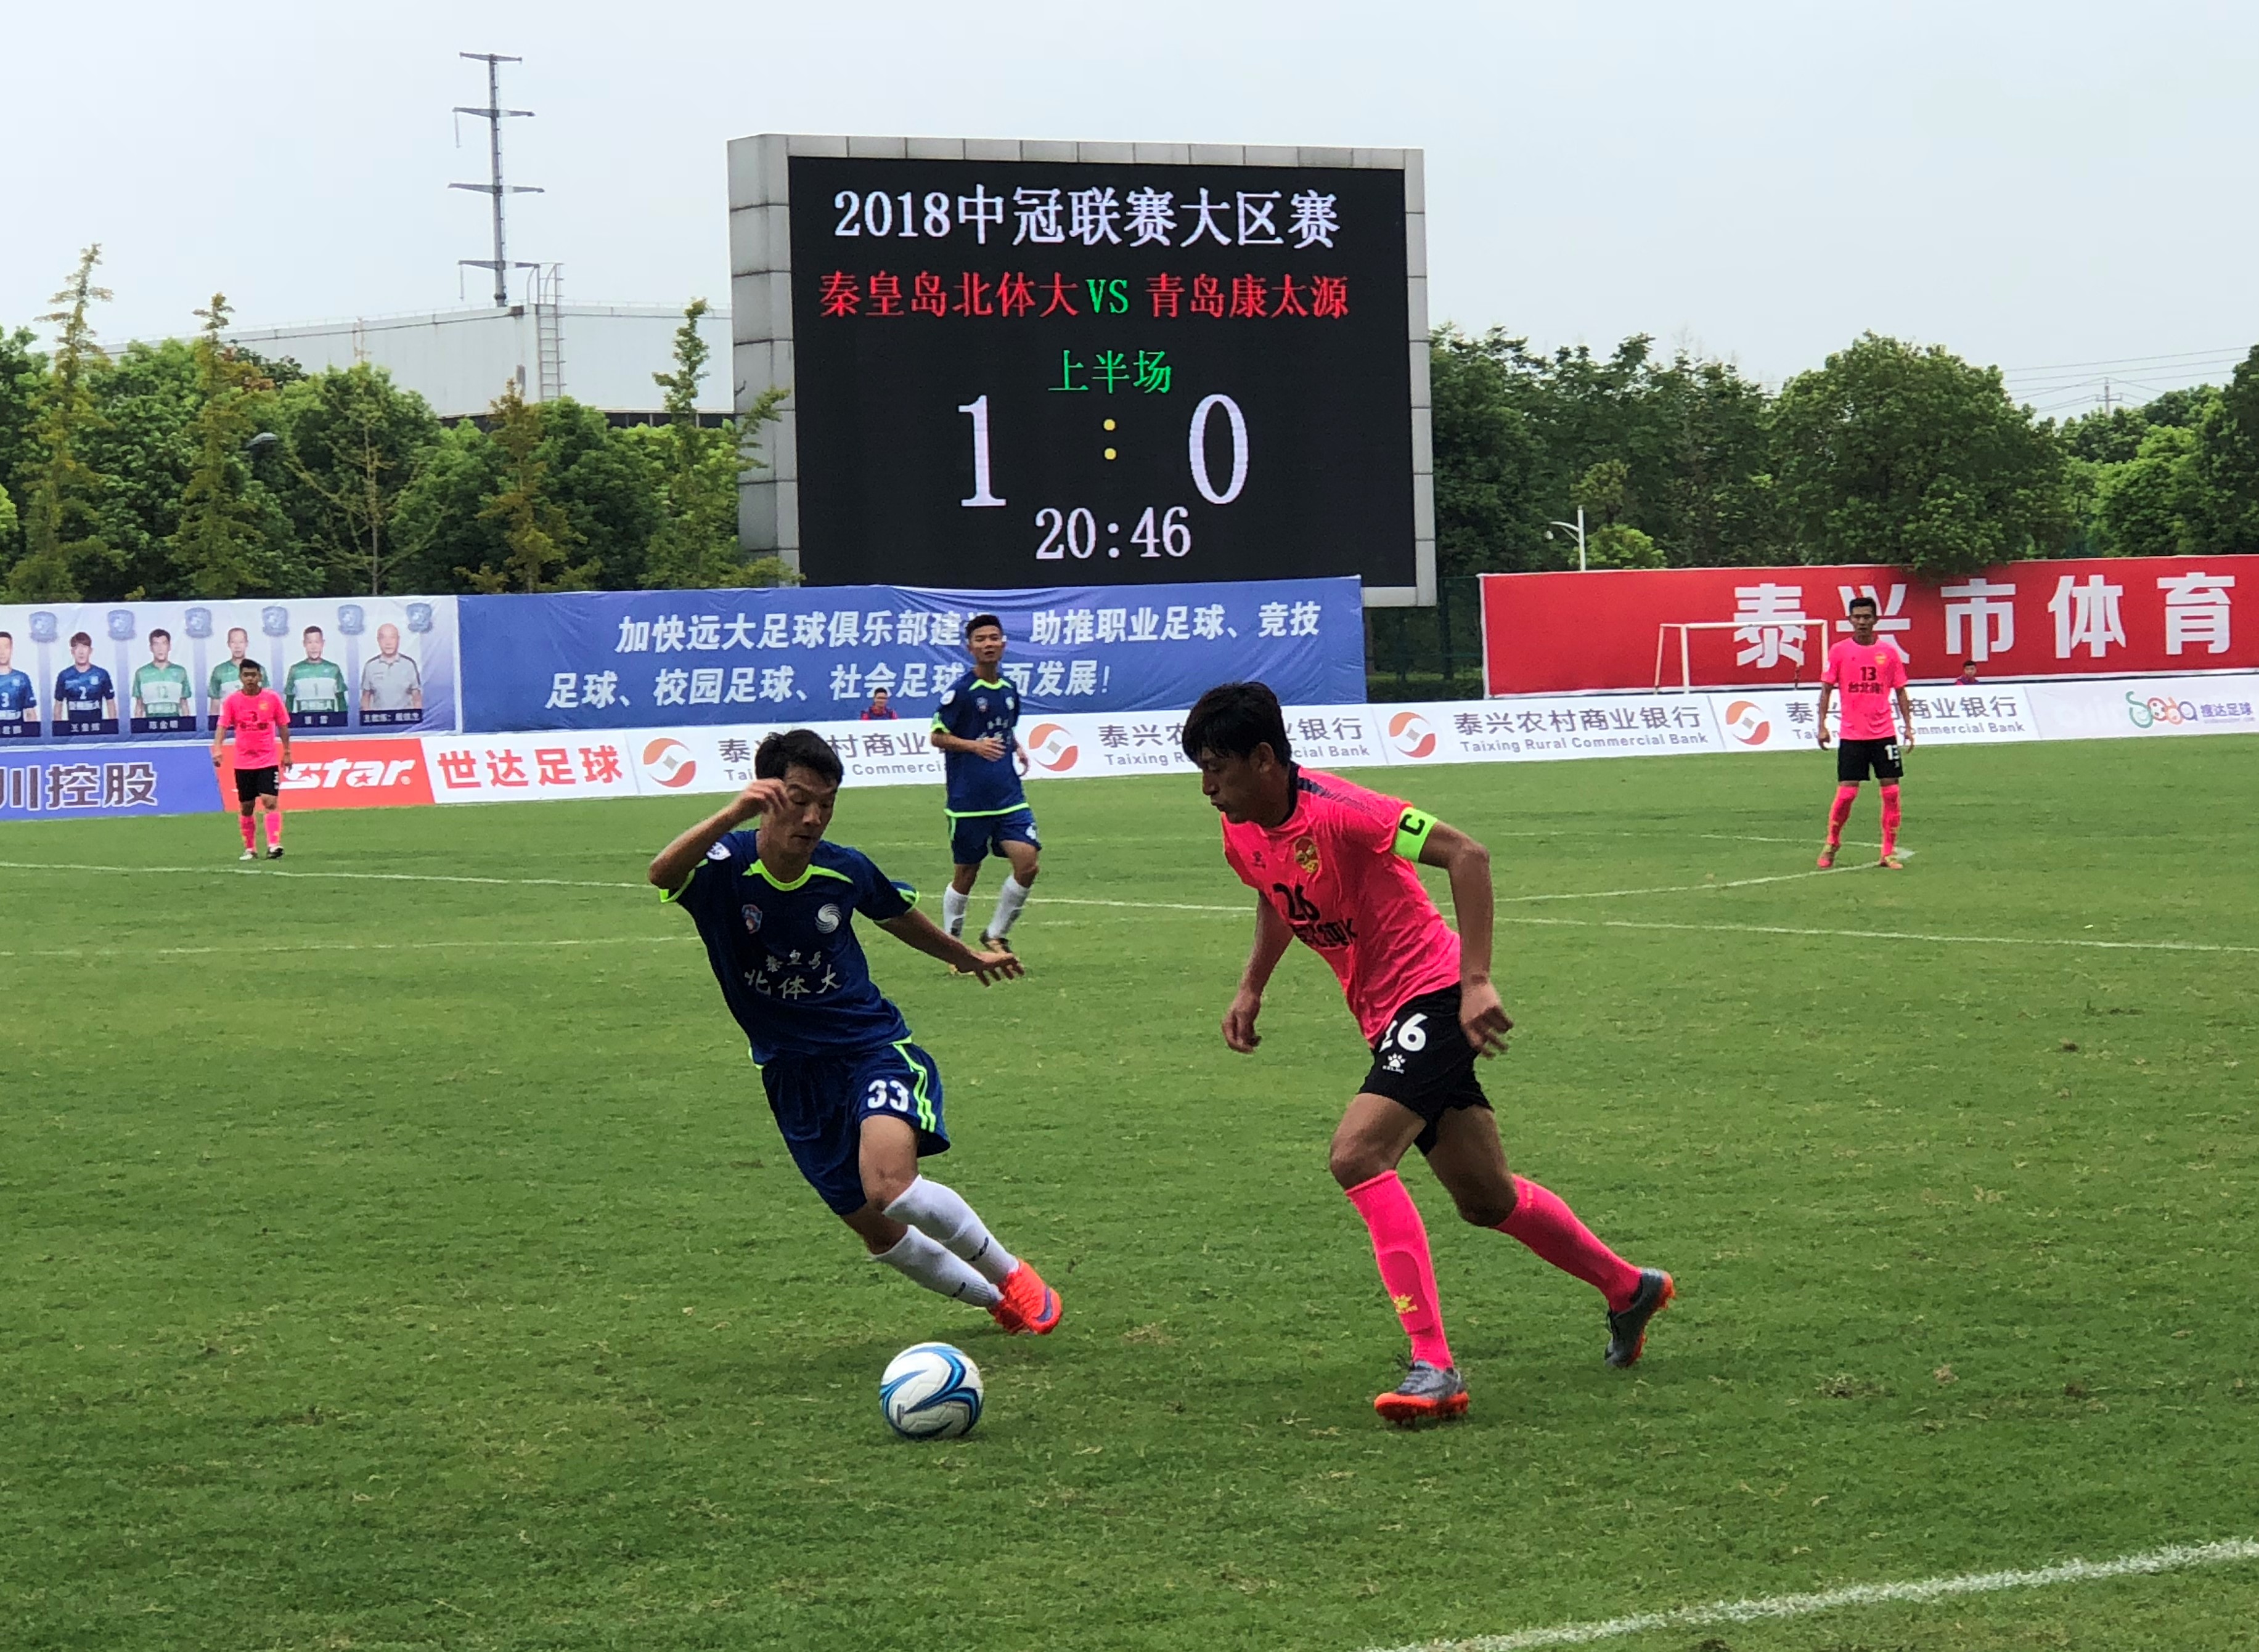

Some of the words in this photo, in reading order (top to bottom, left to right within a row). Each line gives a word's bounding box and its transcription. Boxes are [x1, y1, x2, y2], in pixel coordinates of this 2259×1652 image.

[833, 184, 1341, 249] 2018中冠联赛大区赛
[819, 270, 1079, 319] 秦皇岛北体大
[1086, 277, 1130, 316] VS
[1145, 274, 1349, 319] 青岛康太源
[1048, 349, 1172, 394] 上半场
[958, 394, 1007, 507] 1
[1187, 393, 1249, 505] 0
[1034, 505, 1192, 561] 20:46
[1733, 572, 2236, 669] 泰兴市体育
[1860, 666, 1877, 682] 13
[1453, 706, 1701, 736] 泰兴农村商业银行
[1988, 721, 2025, 733] Bank
[1105, 752, 1168, 767] Taixing
[1329, 744, 1370, 758] Bank
[1460, 739, 1521, 753] Taixing
[1526, 737, 1567, 751] Rural
[1572, 734, 1665, 749] Commercial
[1670, 732, 1709, 745] Bank
[437, 745, 623, 789] 世达足球
[1399, 813, 1426, 836] C
[1272, 882, 1321, 921] 26
[744, 964, 842, 999] 北体大
[867, 1080, 909, 1112] 33
